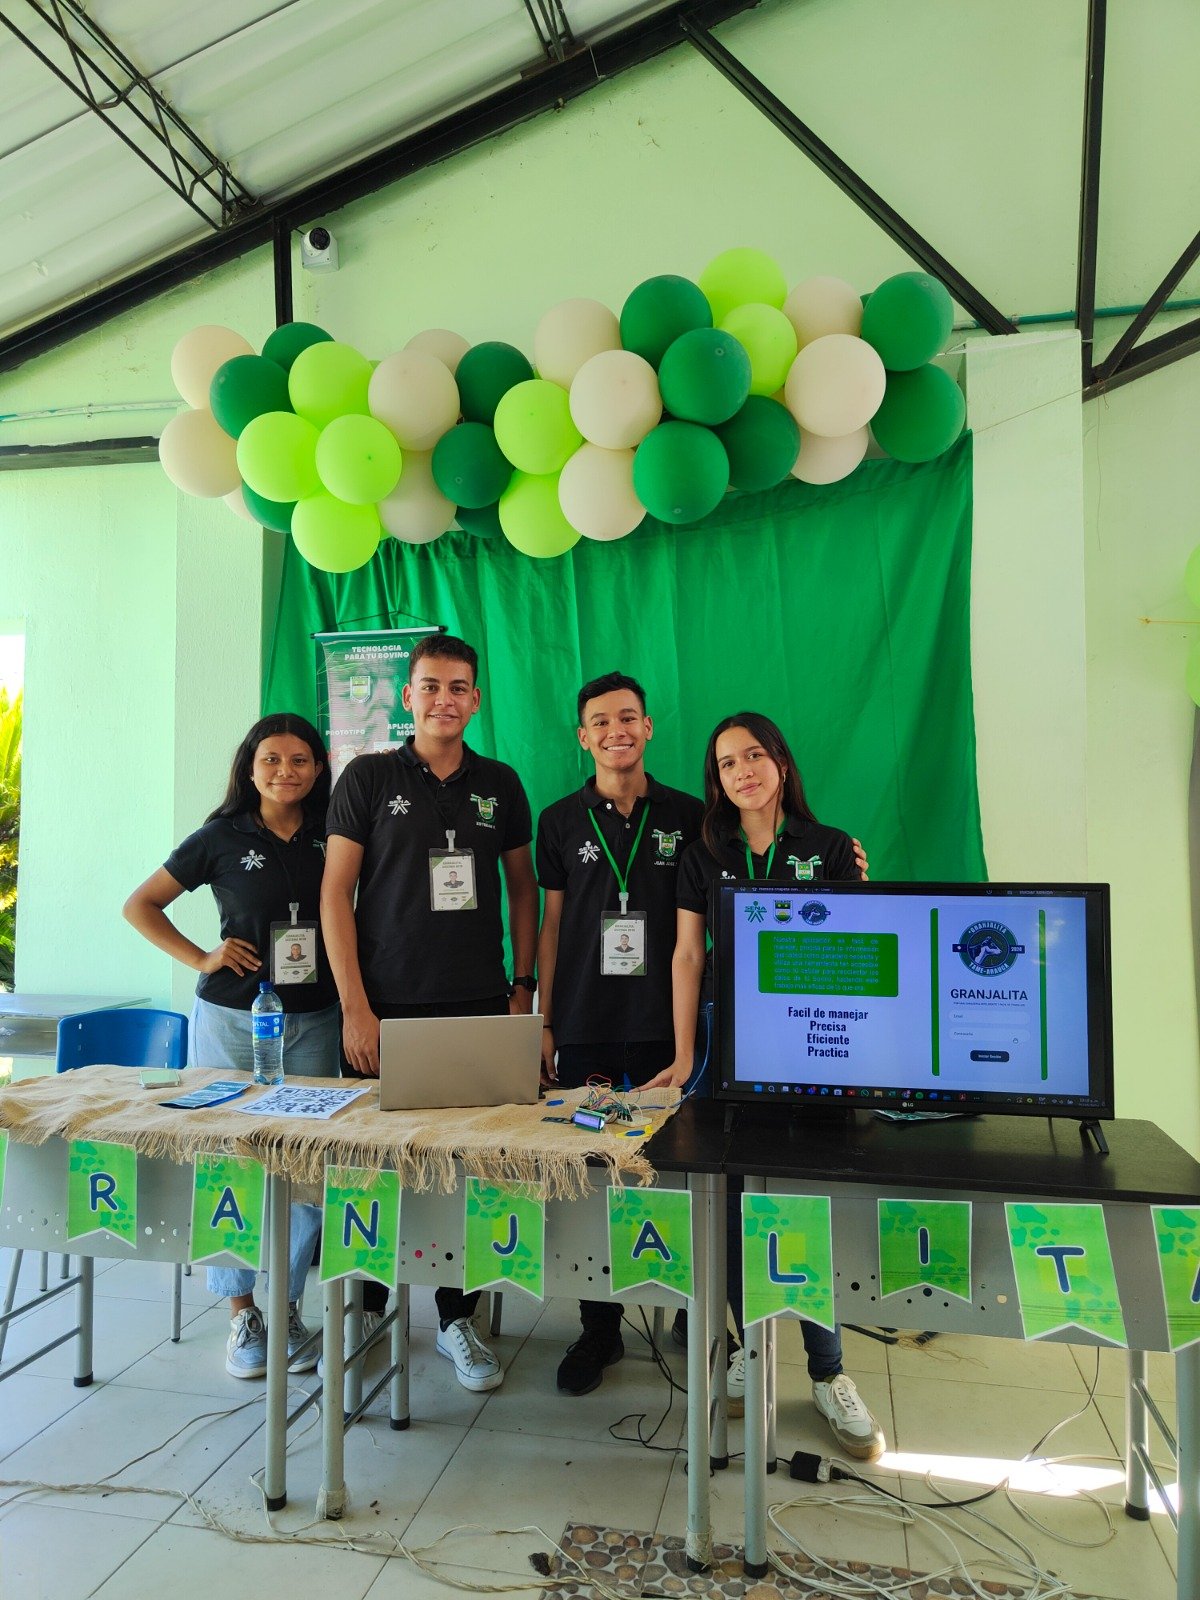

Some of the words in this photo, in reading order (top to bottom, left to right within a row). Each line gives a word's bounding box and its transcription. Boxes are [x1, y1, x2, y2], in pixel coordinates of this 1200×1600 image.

[351, 645, 402, 653] TECNOLOGIA
[378, 651, 409, 659] BOVINO
[387, 722, 415, 730] APLICA
[950, 988, 1029, 1001] GRANJALITA
[788, 1006, 811, 1018] Facil
[814, 1007, 826, 1018] de
[828, 1009, 869, 1021] manejar
[810, 1020, 847, 1032] Precisa
[807, 1033, 850, 1045] Eficiente
[807, 1046, 850, 1058] Practica
[89, 1172, 118, 1212] R
[210, 1186, 245, 1231] A
[343, 1200, 379, 1248] N
[492, 1214, 518, 1256] J
[631, 1219, 672, 1262] A
[767, 1231, 808, 1285] L
[1036, 1245, 1086, 1294] T
